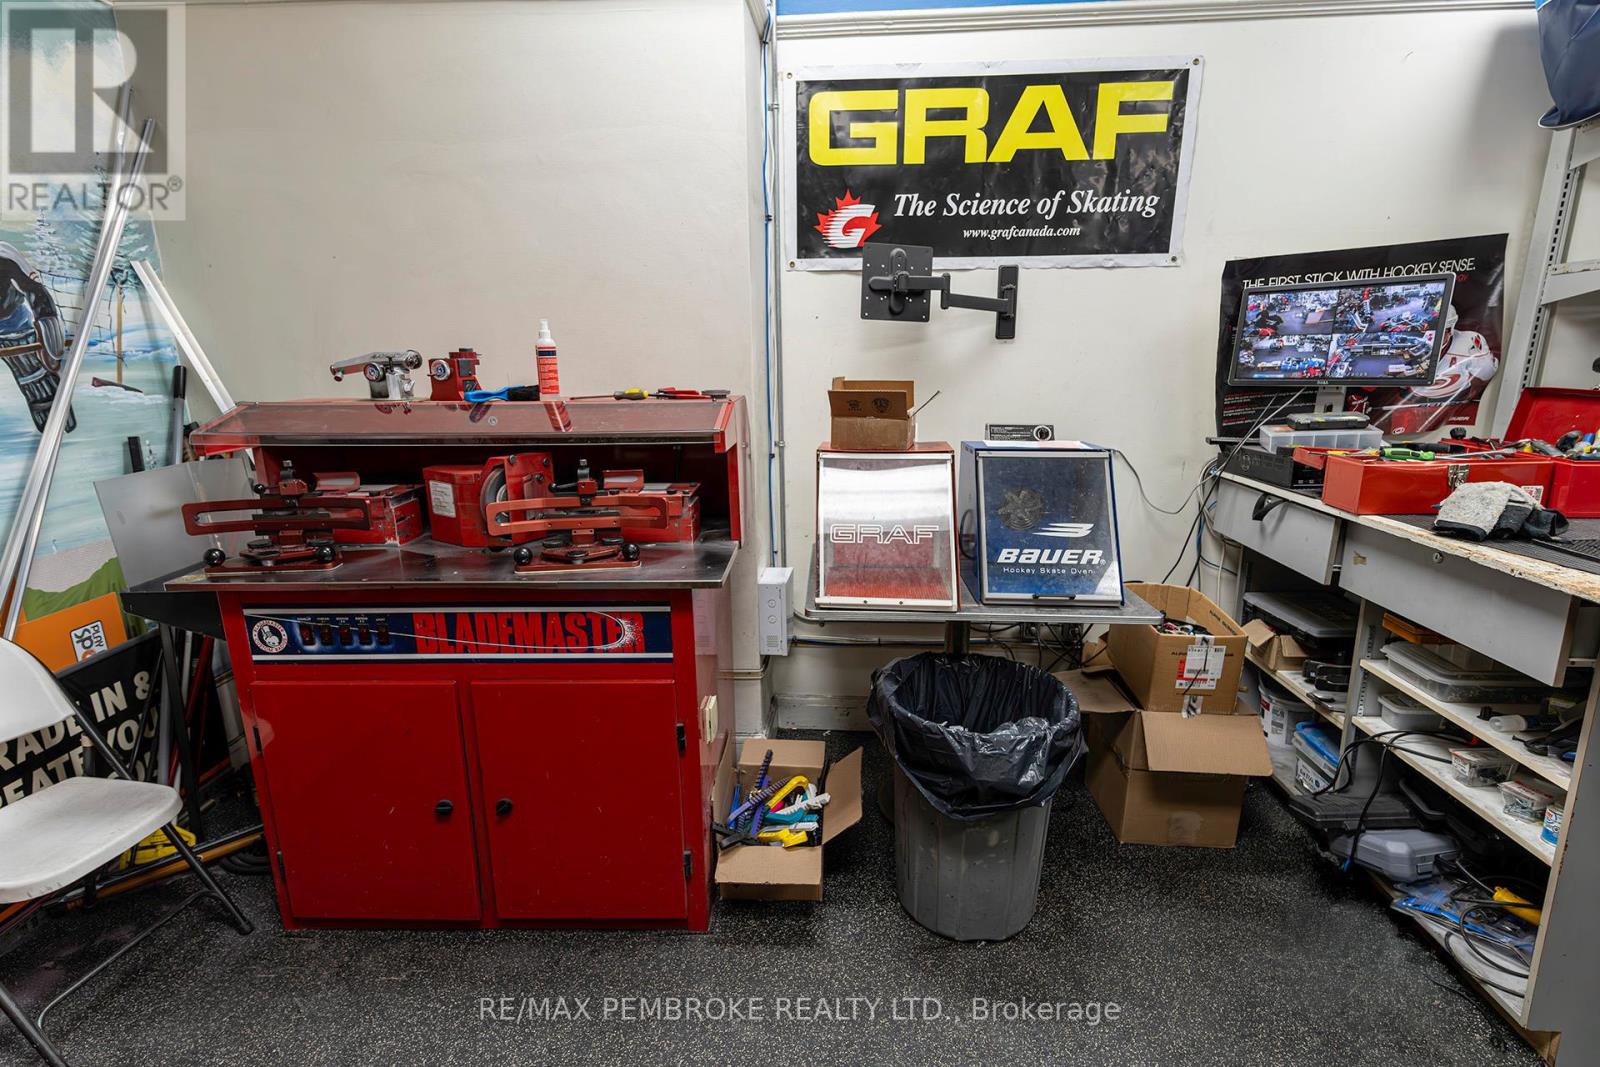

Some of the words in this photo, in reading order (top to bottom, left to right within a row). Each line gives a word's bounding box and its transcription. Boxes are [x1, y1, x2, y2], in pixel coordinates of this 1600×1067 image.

[809, 81, 1174, 166] GRAF
[893, 193, 937, 217] The
[942, 192, 1029, 217] Science
[1037, 190, 1064, 220] of
[1066, 188, 1161, 217] Skating
[963, 225, 1081, 240] www.grafcanada.com
[1242, 277, 1265, 288] THE
[1268, 275, 1302, 287] FIRST
[1304, 271, 1343, 284] STICK
[1347, 267, 1381, 281] WITH
[1384, 261, 1437, 279] HOCKEY
[1439, 257, 1476, 273] SENSE.
[830, 523, 940, 545] GRAF
[412, 612, 647, 654] BLADEMASTER
[90, 681, 128, 723] IN
[133, 671, 156, 700] &
